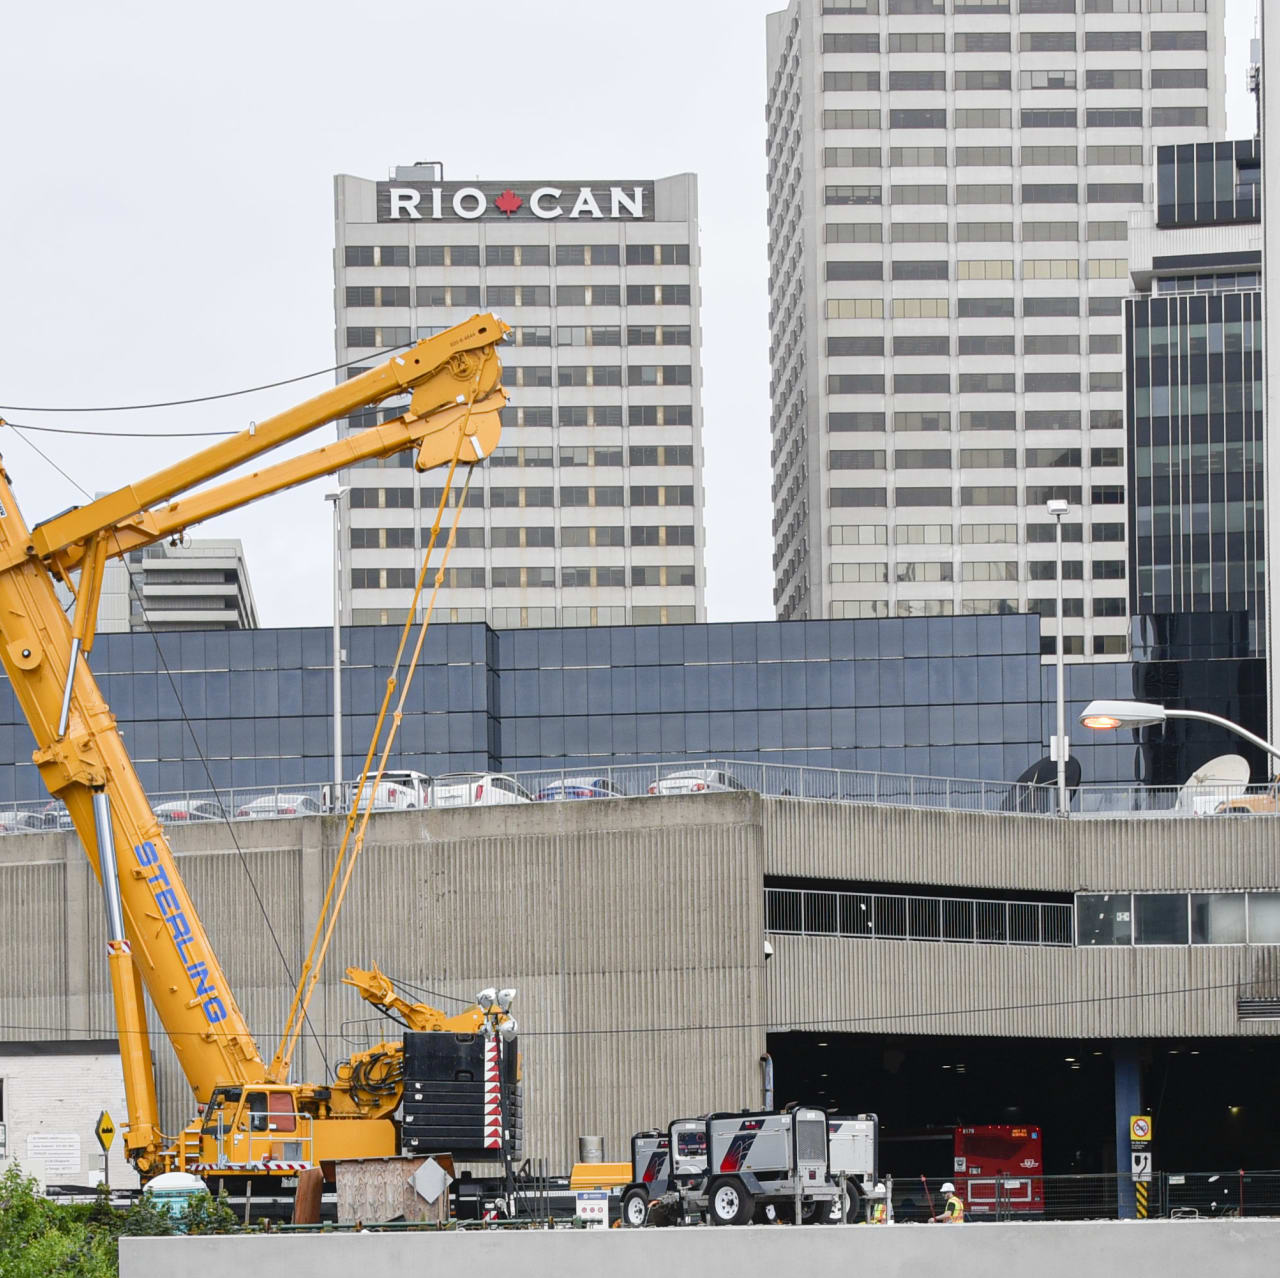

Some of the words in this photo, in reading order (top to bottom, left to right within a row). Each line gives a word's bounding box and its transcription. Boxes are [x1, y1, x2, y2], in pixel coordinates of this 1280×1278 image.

[389, 187, 487, 219] RIO
[529, 187, 644, 219] CAN
[134, 840, 228, 1024] STERLING
